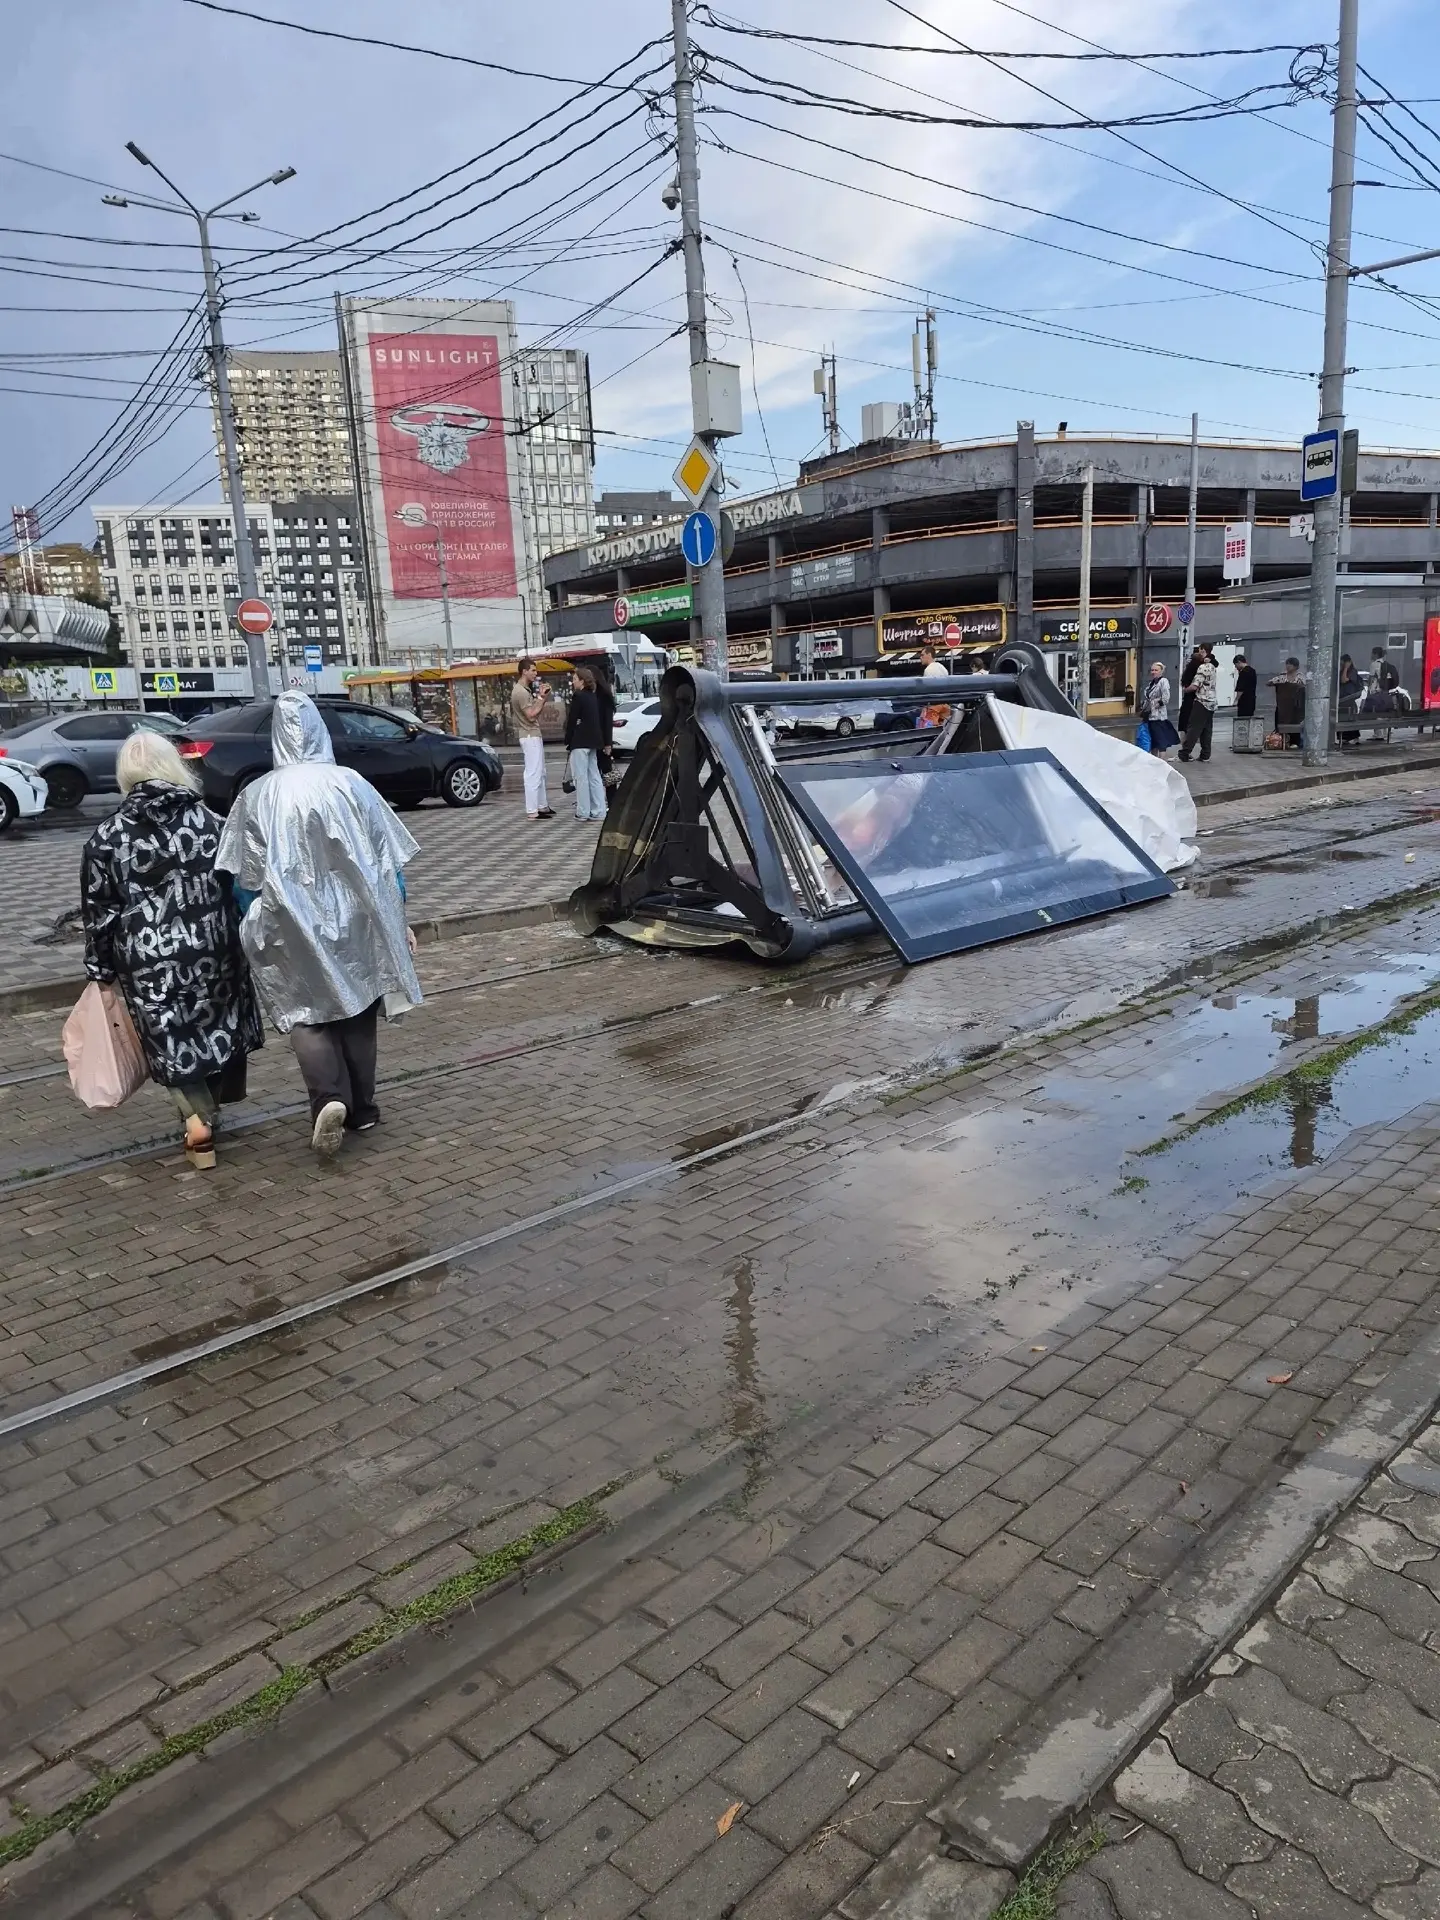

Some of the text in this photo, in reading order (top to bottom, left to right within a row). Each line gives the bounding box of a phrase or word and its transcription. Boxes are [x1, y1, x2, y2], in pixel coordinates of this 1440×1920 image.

[375, 348, 493, 365] SUNLIGHT
[430, 502, 489, 510] ЮВЕЛИРНОЕ
[431, 511, 496, 519] ПРИЛОЖЕНИЕ
[1300, 525, 1306, 533] 7
[465, 543, 478, 552] ТЦ
[479, 543, 508, 551] ТАЛЕР
[424, 553, 437, 561] ТЦ
[1149, 612, 1165, 626] 24
[1059, 621, 1106, 633] СЕЙАС!
